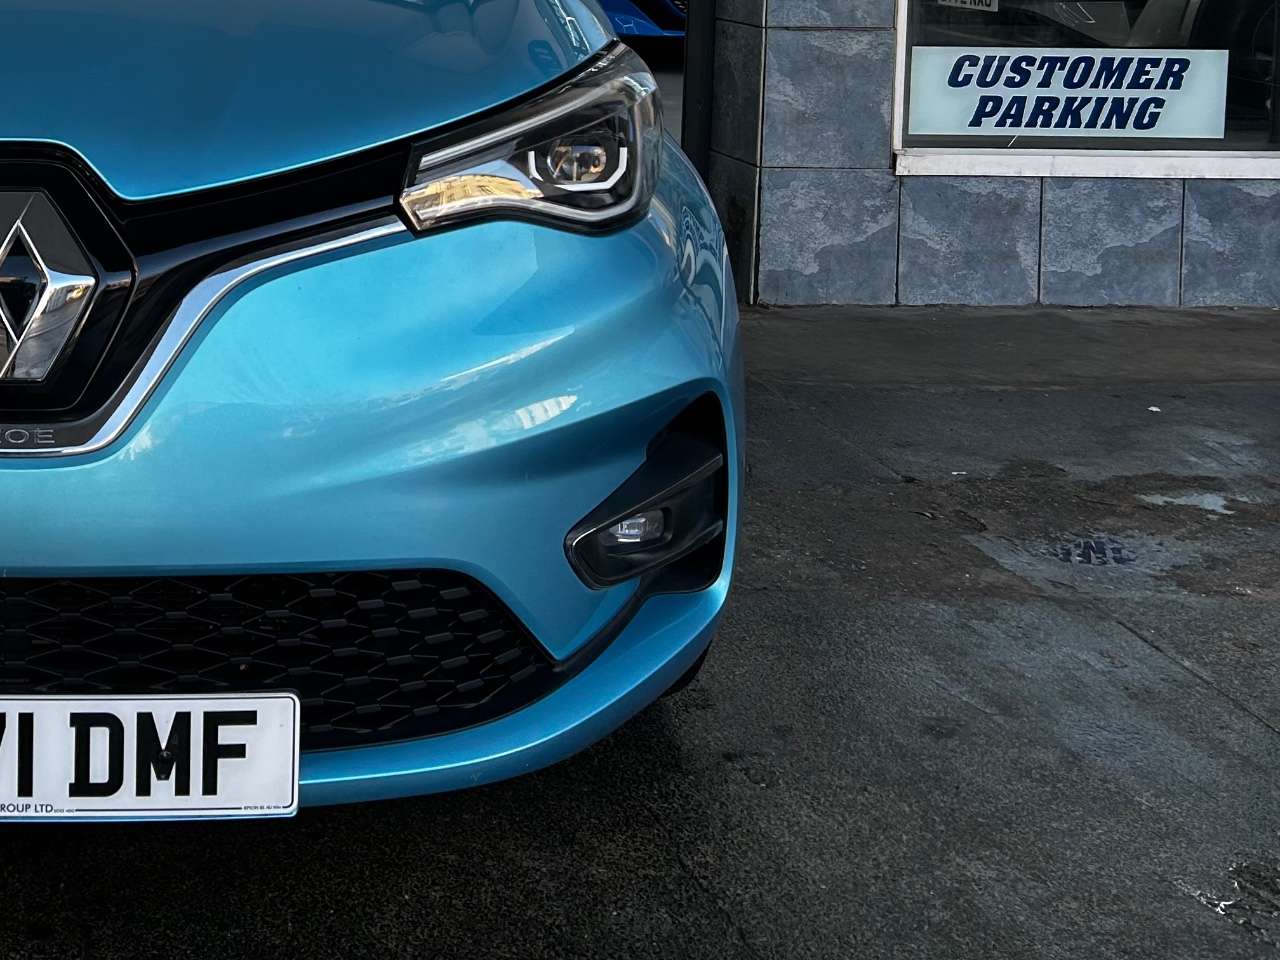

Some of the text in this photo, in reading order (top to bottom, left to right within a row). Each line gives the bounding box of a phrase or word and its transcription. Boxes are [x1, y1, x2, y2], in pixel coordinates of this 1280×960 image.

[947, 54, 1191, 91] CUSTOMER
[967, 94, 1166, 131] PARKING
[68, 709, 258, 798] DMF
[34, 803, 54, 813] LTD
